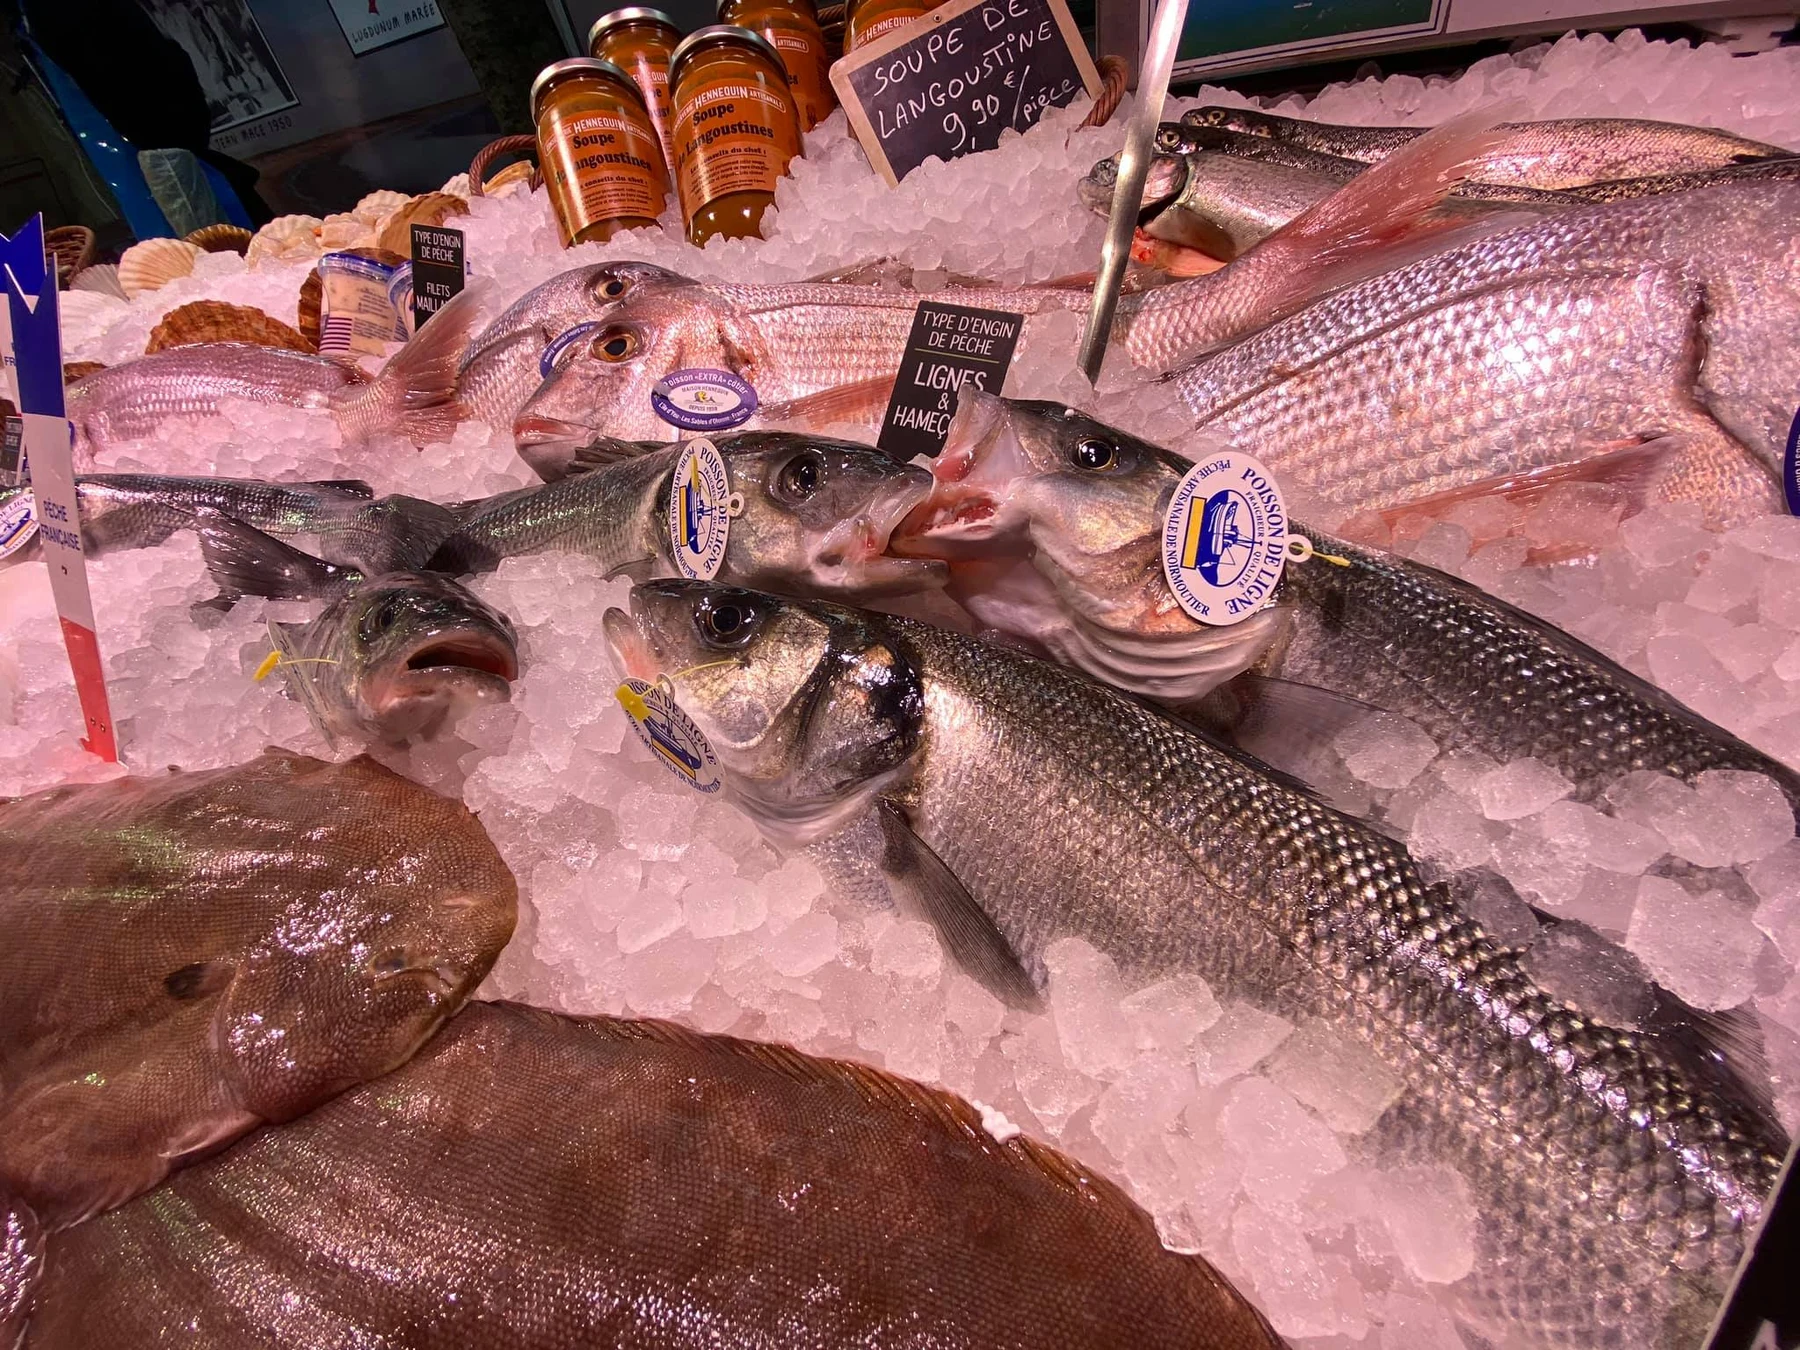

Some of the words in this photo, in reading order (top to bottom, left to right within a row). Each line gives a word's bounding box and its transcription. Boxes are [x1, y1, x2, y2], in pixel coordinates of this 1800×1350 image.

[352, 16, 401, 43] LUGDUNUM
[404, 3, 435, 24] MARÉE
[874, 27, 964, 97] SOUPE
[983, 0, 1029, 32] DE
[878, 20, 1053, 140] LANGOUSTINE
[695, 86, 748, 109] HENNEQUIN
[267, 115, 293, 132] 1950
[573, 117, 627, 133] HENNEQUIN
[692, 103, 735, 126] Soupe
[572, 133, 615, 149] Soupe
[414, 230, 432, 245] TYPE
[433, 233, 461, 249] D'ENGIN
[421, 247, 432, 258] DE
[426, 282, 451, 297] FILETS
[922, 310, 956, 330] TYPE
[958, 316, 1015, 339] D'ENGIN
[928, 331, 948, 348] DE
[950, 333, 994, 356] PÊCHE
[914, 362, 988, 392] LIGNES
[938, 392, 949, 410] &
[699, 447, 727, 501] POISSON
[671, 471, 683, 522] ARTISANALE
[1167, 476, 1200, 534] ARTISANALE
[1240, 467, 1285, 539] POISSON
[671, 523, 678, 535] DE
[718, 505, 727, 525] DE
[40, 523, 81, 551] FRANÇAISE
[1166, 533, 1178, 549] DE
[673, 535, 698, 580] NOIRMOUTIER
[703, 529, 724, 574] LIGNE
[1263, 541, 1284, 568] DE
[1166, 549, 1211, 617] NOIRMOUTIER
[1225, 570, 1276, 615] LIGNE
[664, 695, 680, 718] DE
[682, 714, 718, 766] LIGNE
